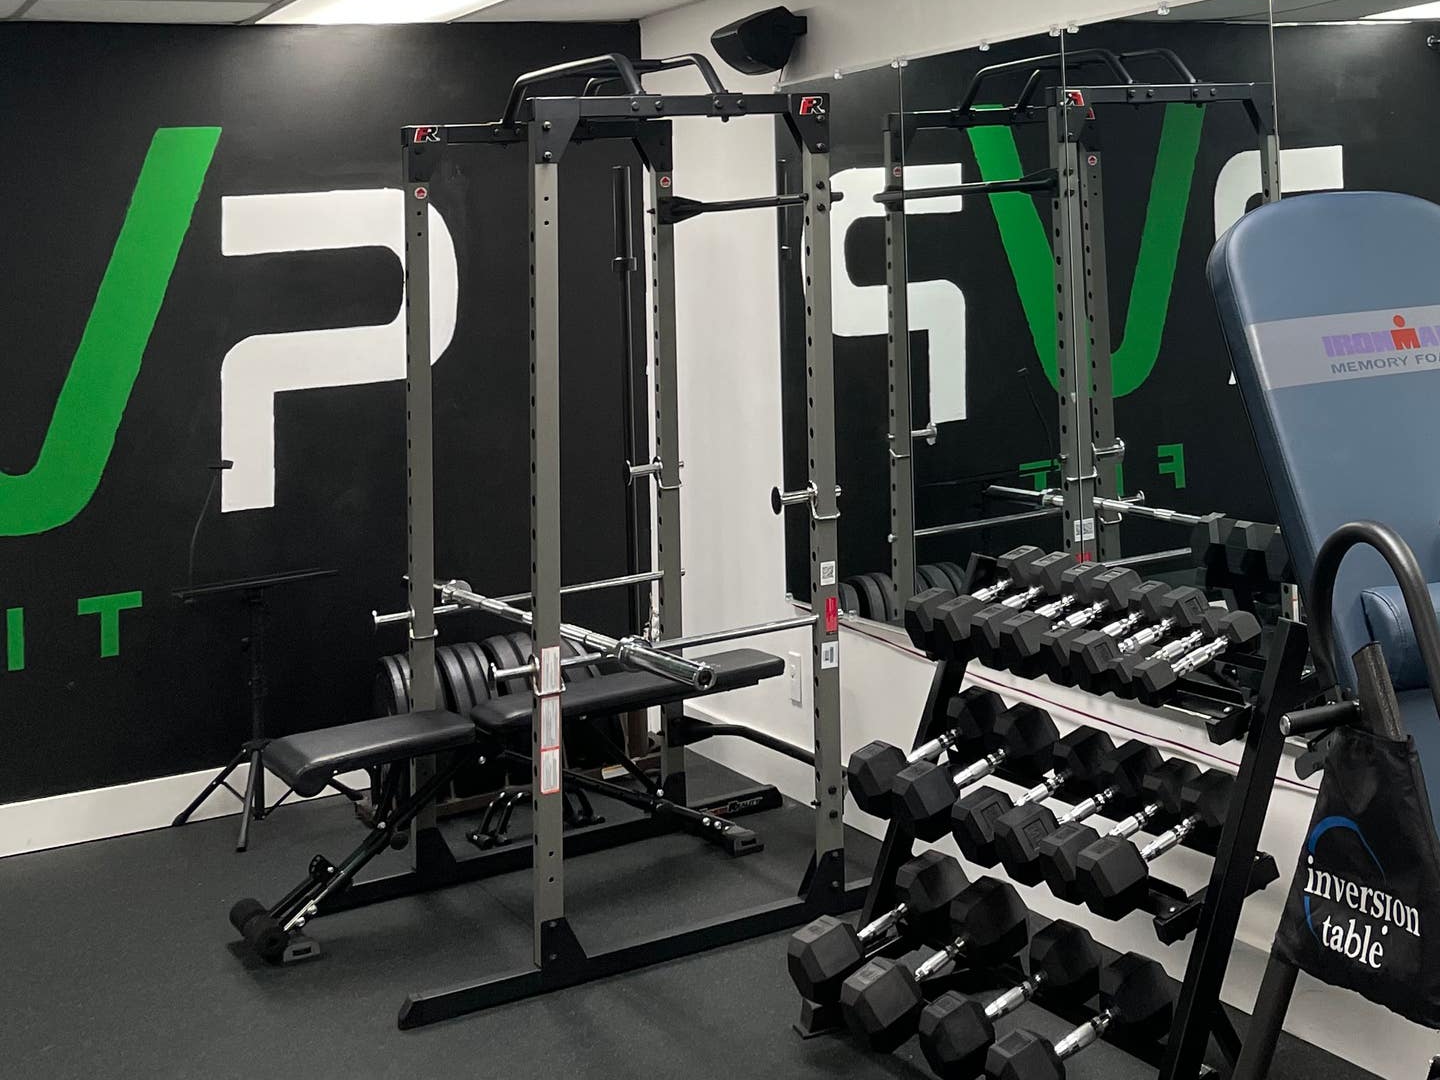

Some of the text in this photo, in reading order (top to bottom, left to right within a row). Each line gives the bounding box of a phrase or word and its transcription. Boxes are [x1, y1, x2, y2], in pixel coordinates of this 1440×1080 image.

[1331, 354, 1408, 375] MEMORY
[1303, 855, 1421, 937] inversion
[1322, 915, 1384, 970] table
